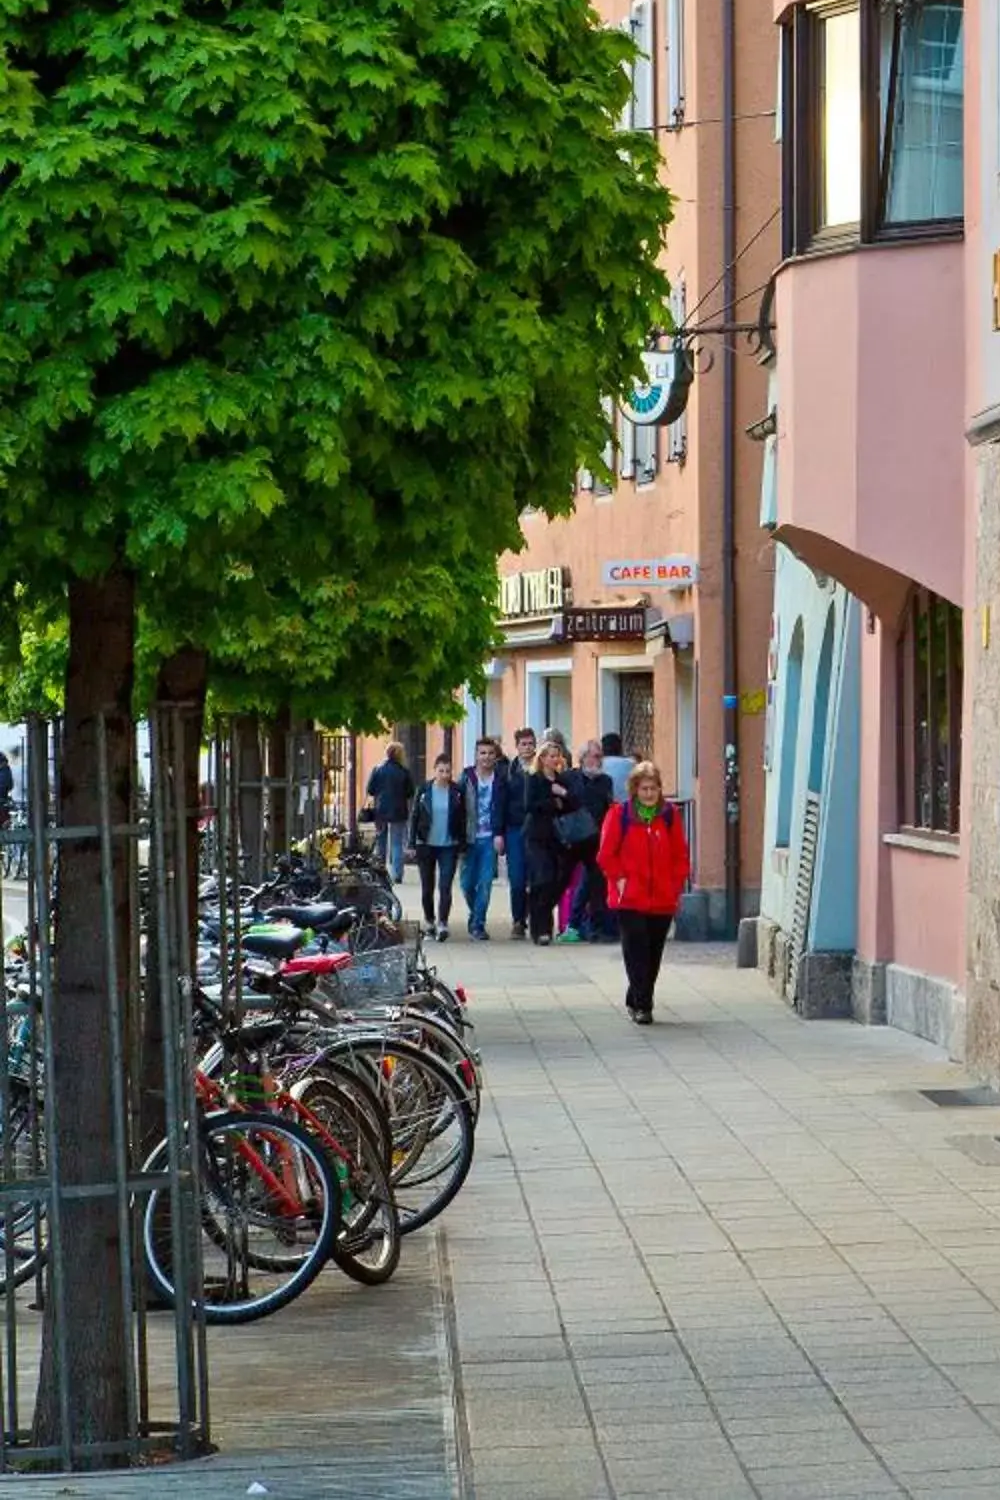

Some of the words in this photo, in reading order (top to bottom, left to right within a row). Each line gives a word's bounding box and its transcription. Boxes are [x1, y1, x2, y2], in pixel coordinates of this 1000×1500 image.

[609, 566, 651, 581] CAFE
[656, 564, 692, 579] BAR
[566, 612, 643, 633] zeitraum
